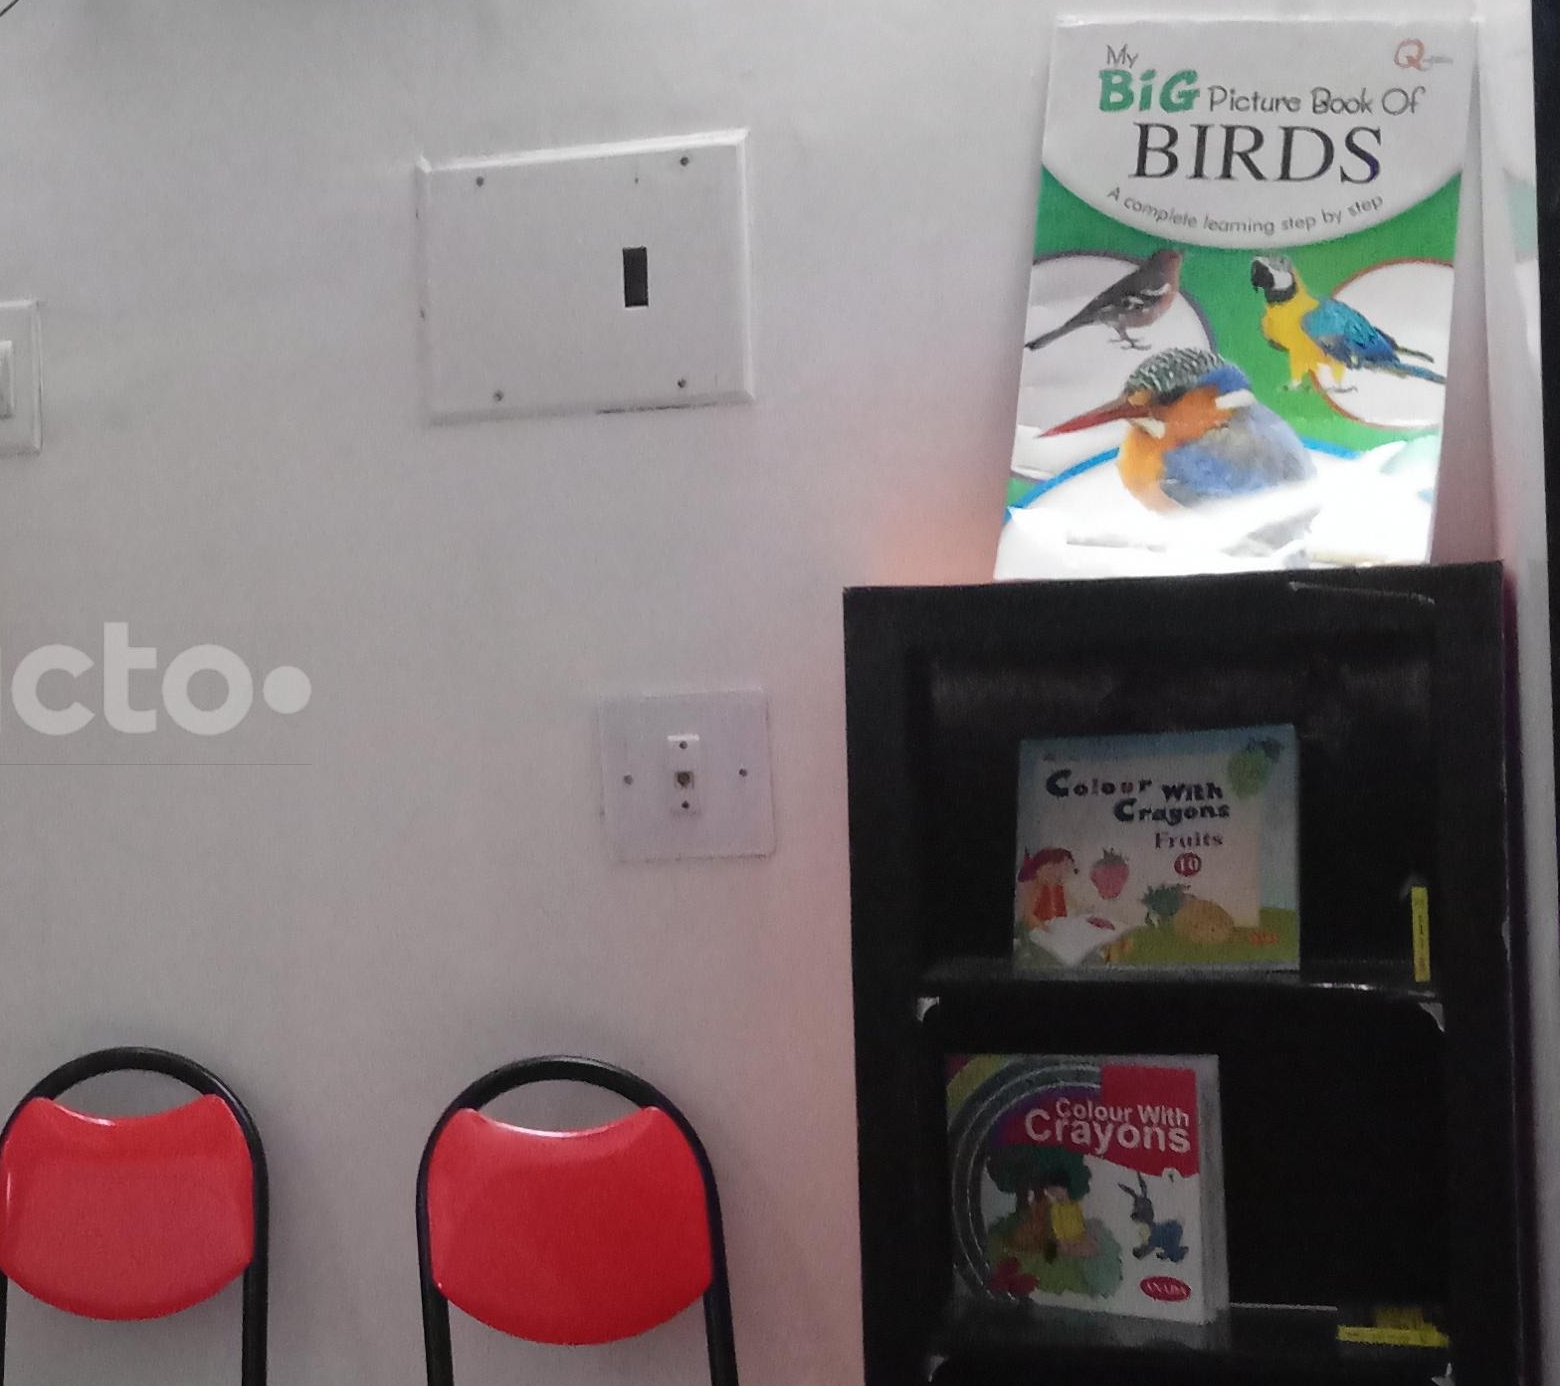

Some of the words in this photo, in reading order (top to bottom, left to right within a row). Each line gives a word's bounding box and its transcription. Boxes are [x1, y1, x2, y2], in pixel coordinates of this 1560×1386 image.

[1105, 43, 1139, 69] My
[1208, 85, 1302, 114] Picture
[1311, 86, 1372, 115] Book
[1381, 85, 1426, 115] Of
[1127, 121, 1382, 185] BIRDS
[1106, 187, 1124, 202] A
[1124, 197, 1198, 230] complete
[1202, 213, 1275, 237] learning
[1281, 213, 1317, 236] step
[1321, 207, 1343, 229] by
[1347, 194, 1384, 219] step
[1045, 768, 1153, 799] Colour
[1113, 797, 1231, 826] Crayons
[1154, 830, 1224, 850] Fruits
[1055, 1096, 1133, 1124] Colour
[1137, 1103, 1190, 1128] With
[1025, 1107, 1191, 1154] Crayons
